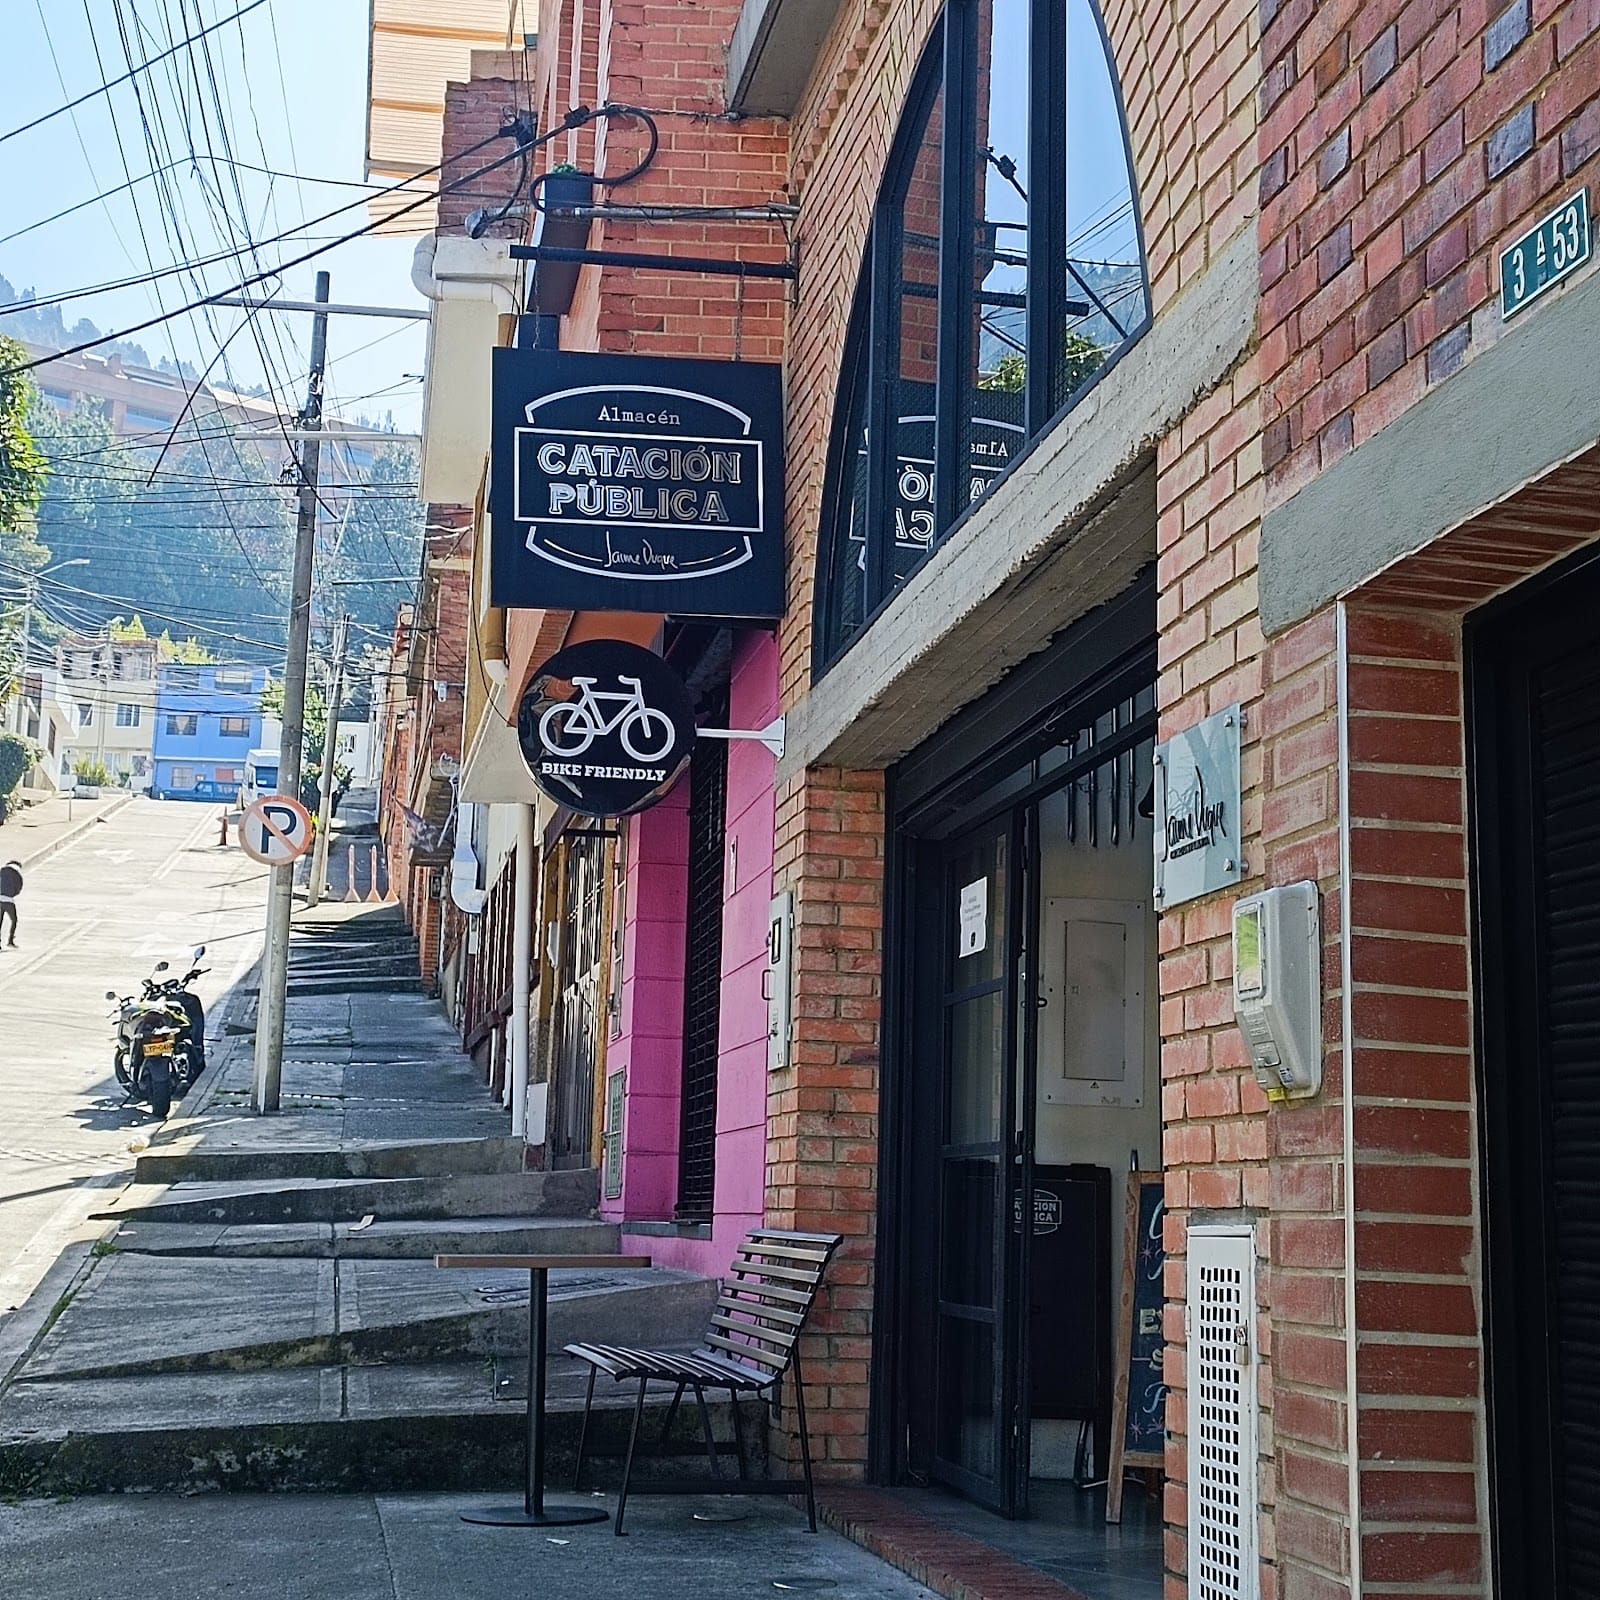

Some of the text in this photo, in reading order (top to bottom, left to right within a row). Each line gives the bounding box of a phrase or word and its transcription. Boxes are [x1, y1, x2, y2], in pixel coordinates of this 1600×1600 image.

[1512, 247, 1525, 300] 3
[1552, 205, 1579, 270] 53
[597, 405, 681, 426] Almacén
[536, 442, 742, 484] CATACIÓN
[548, 478, 730, 523] PÚBLICA
[603, 530, 679, 571] Jaime Duque
[541, 762, 667, 782] BIKE FRIENDLY
[261, 806, 297, 854] P
